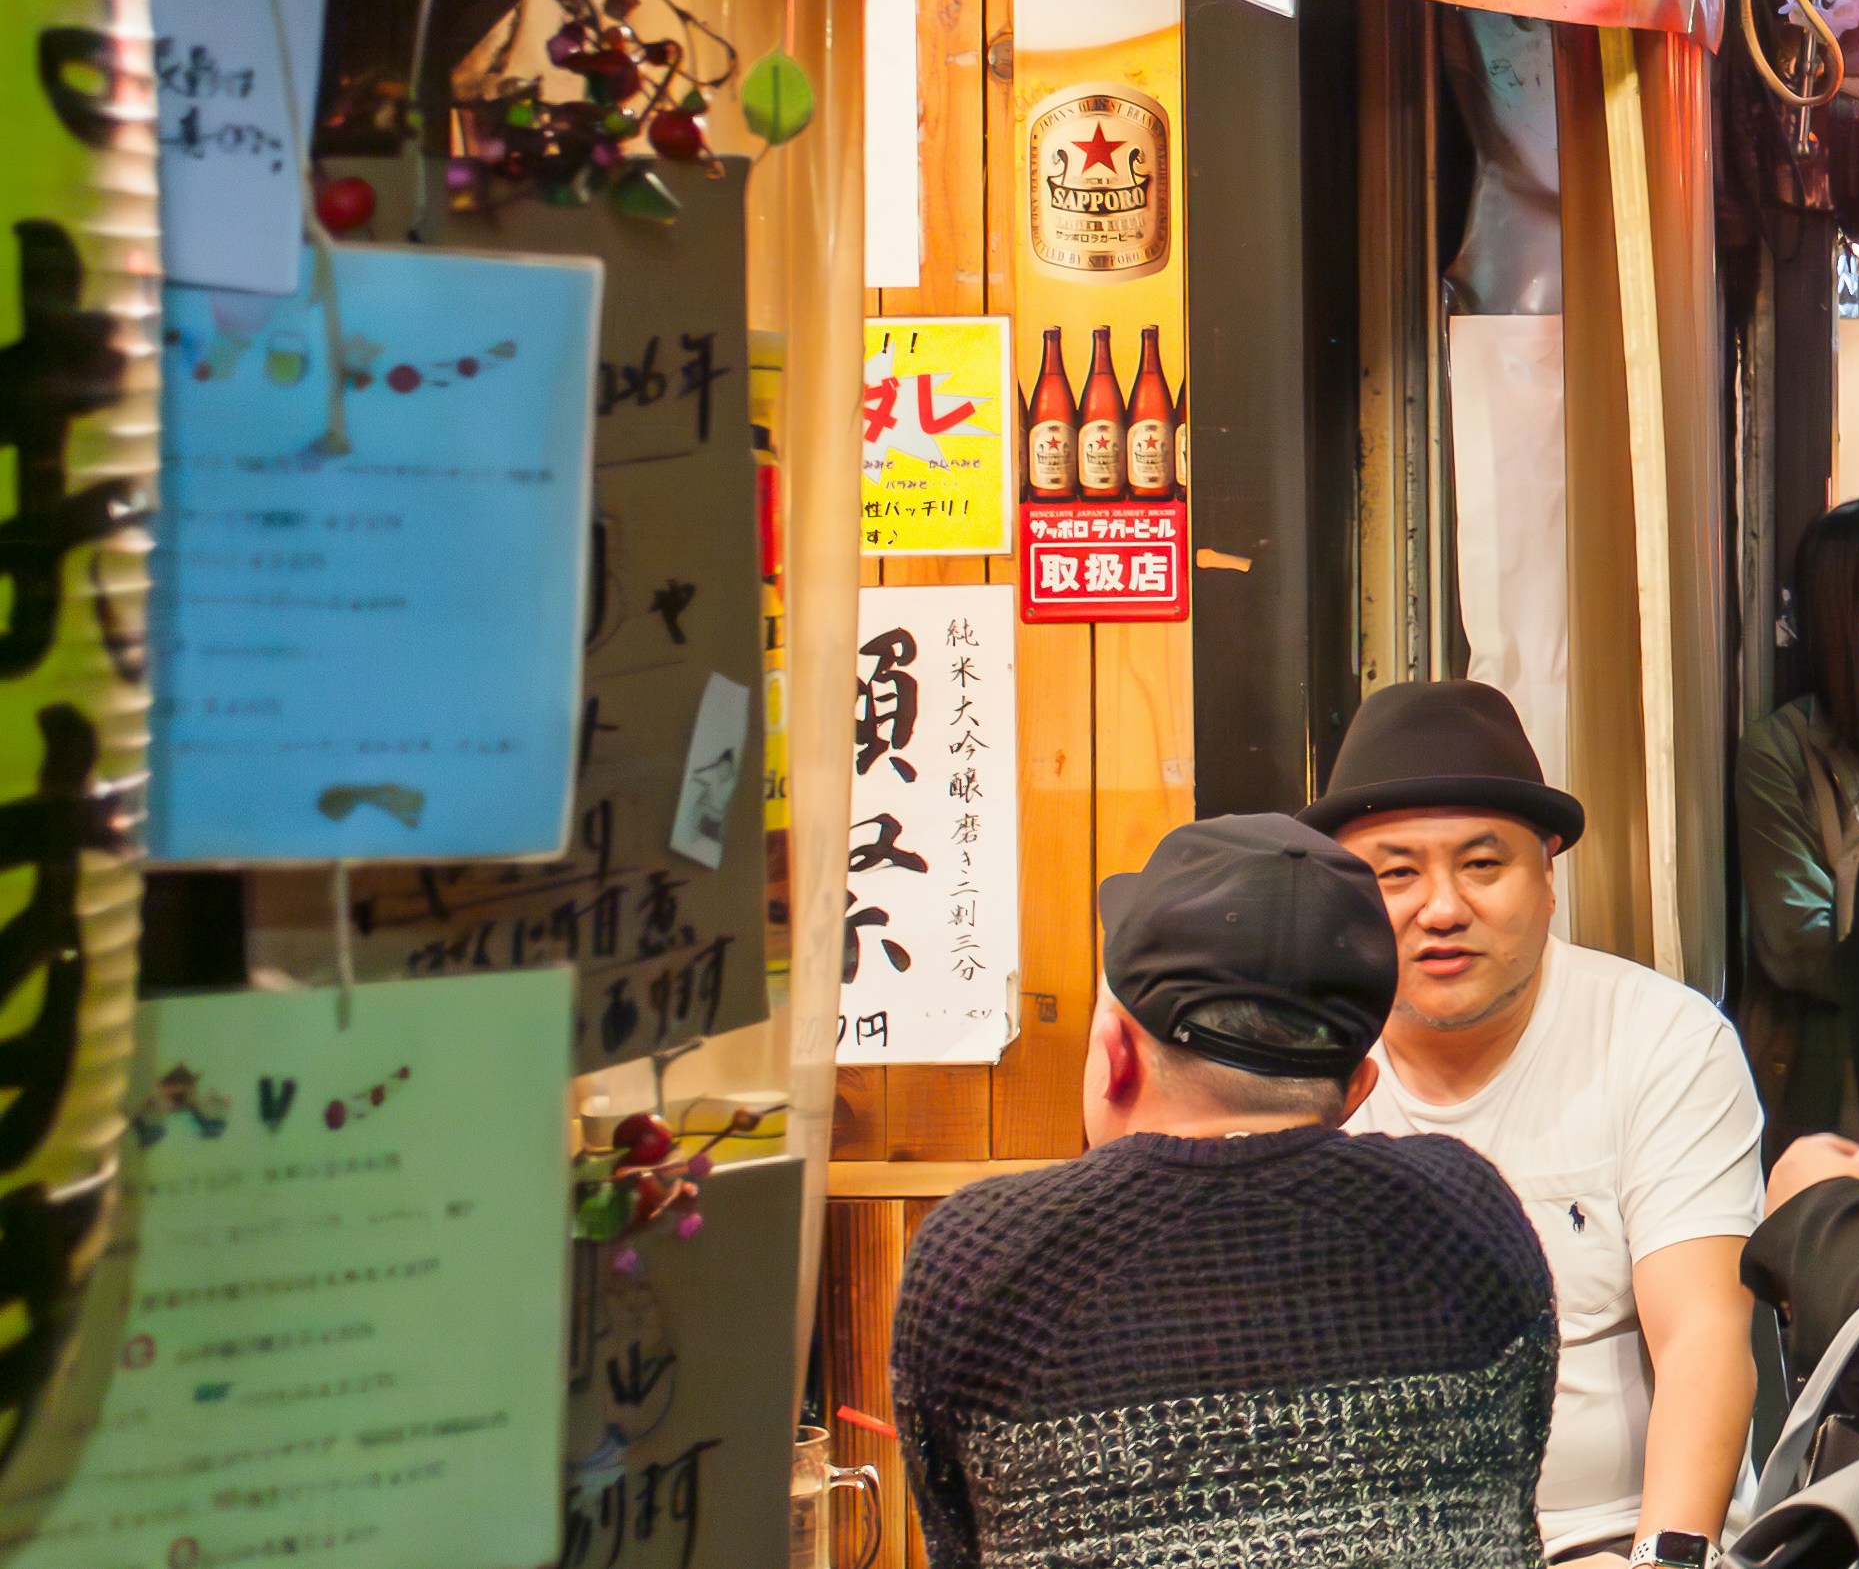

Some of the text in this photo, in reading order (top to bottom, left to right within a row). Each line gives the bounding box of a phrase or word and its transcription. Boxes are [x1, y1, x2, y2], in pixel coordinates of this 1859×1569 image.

[1052, 187, 1146, 212] SAPPORO
[1039, 552, 1168, 593] 取扱店
